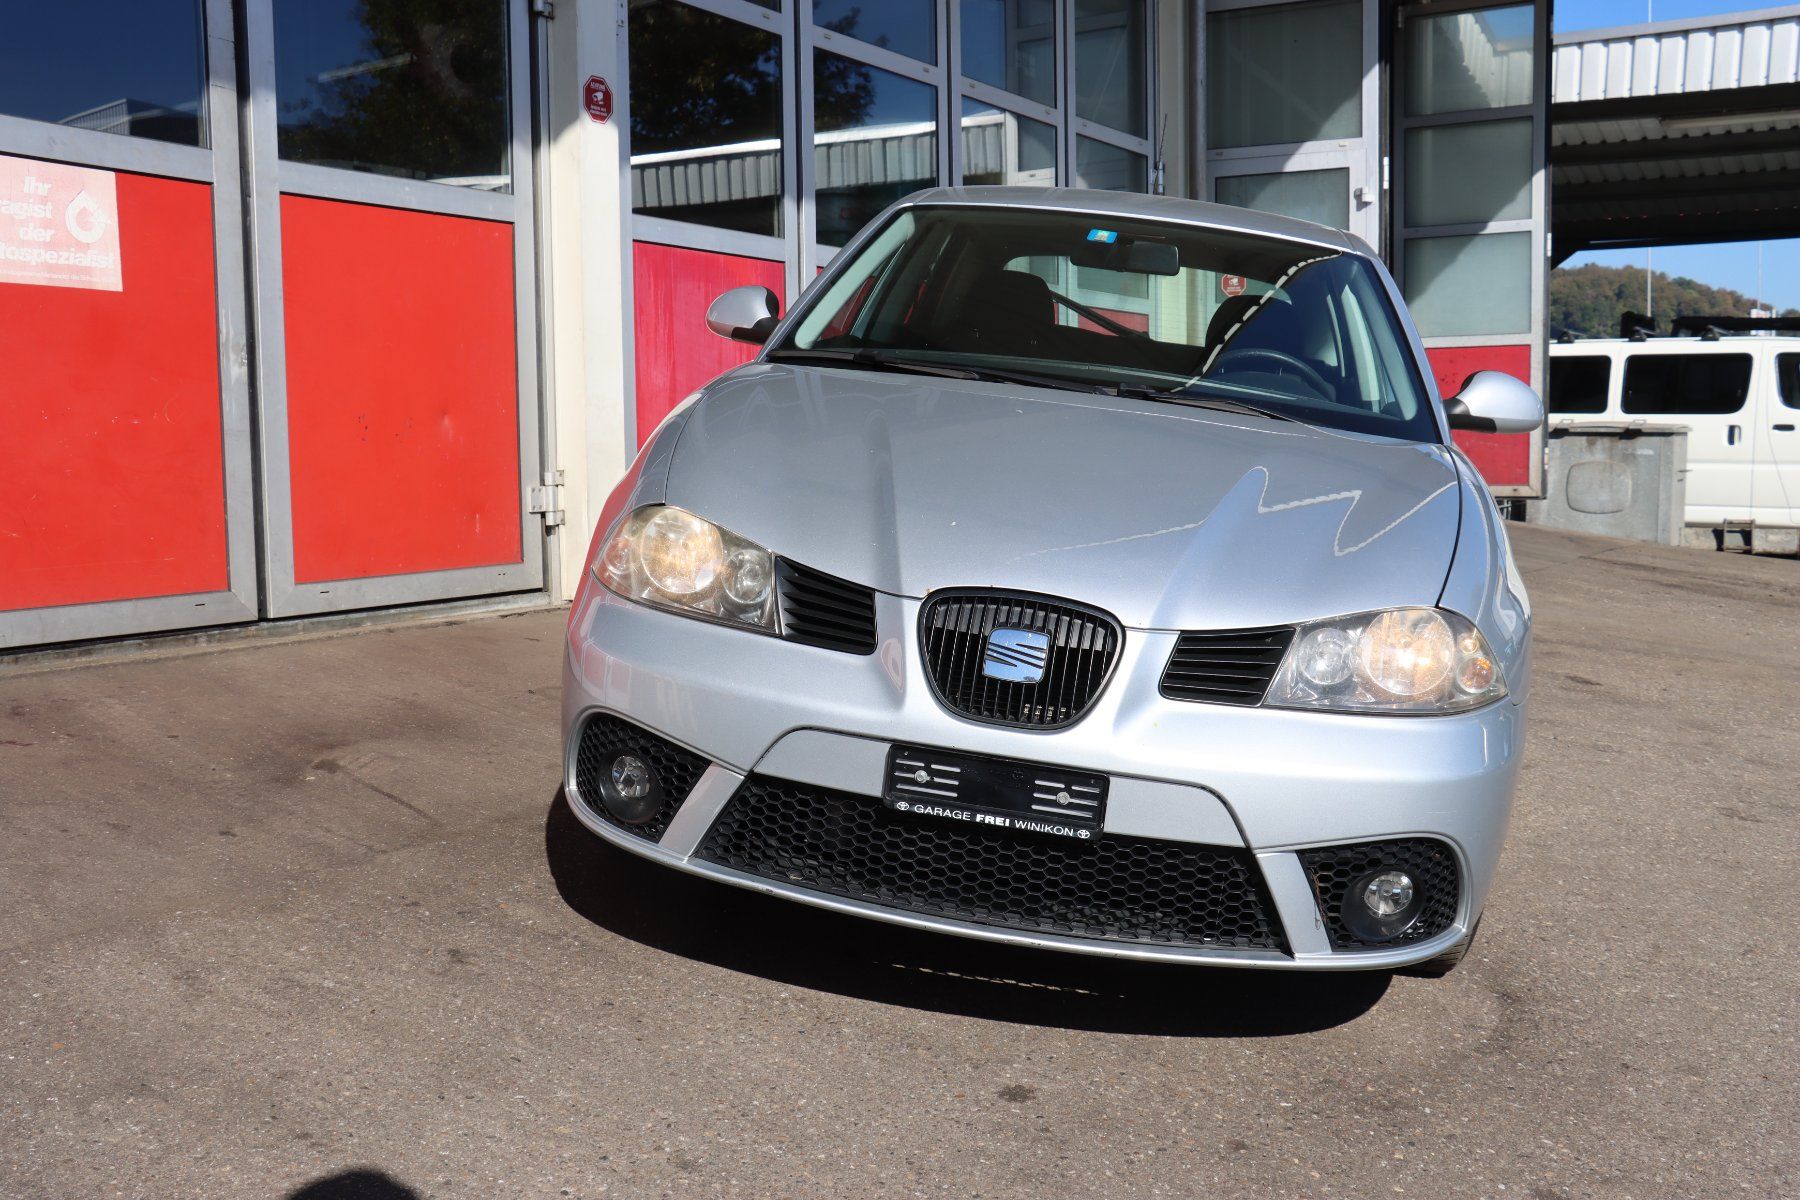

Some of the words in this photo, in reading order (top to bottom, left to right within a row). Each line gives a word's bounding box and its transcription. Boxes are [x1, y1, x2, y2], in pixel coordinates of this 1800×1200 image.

[24, 176, 52, 196] Ihr
[0, 199, 53, 220] agist
[19, 223, 55, 242] der
[914, 804, 971, 821] GARAGE
[975, 813, 1010, 827] FREI
[1014, 819, 1074, 837] WINIKON
